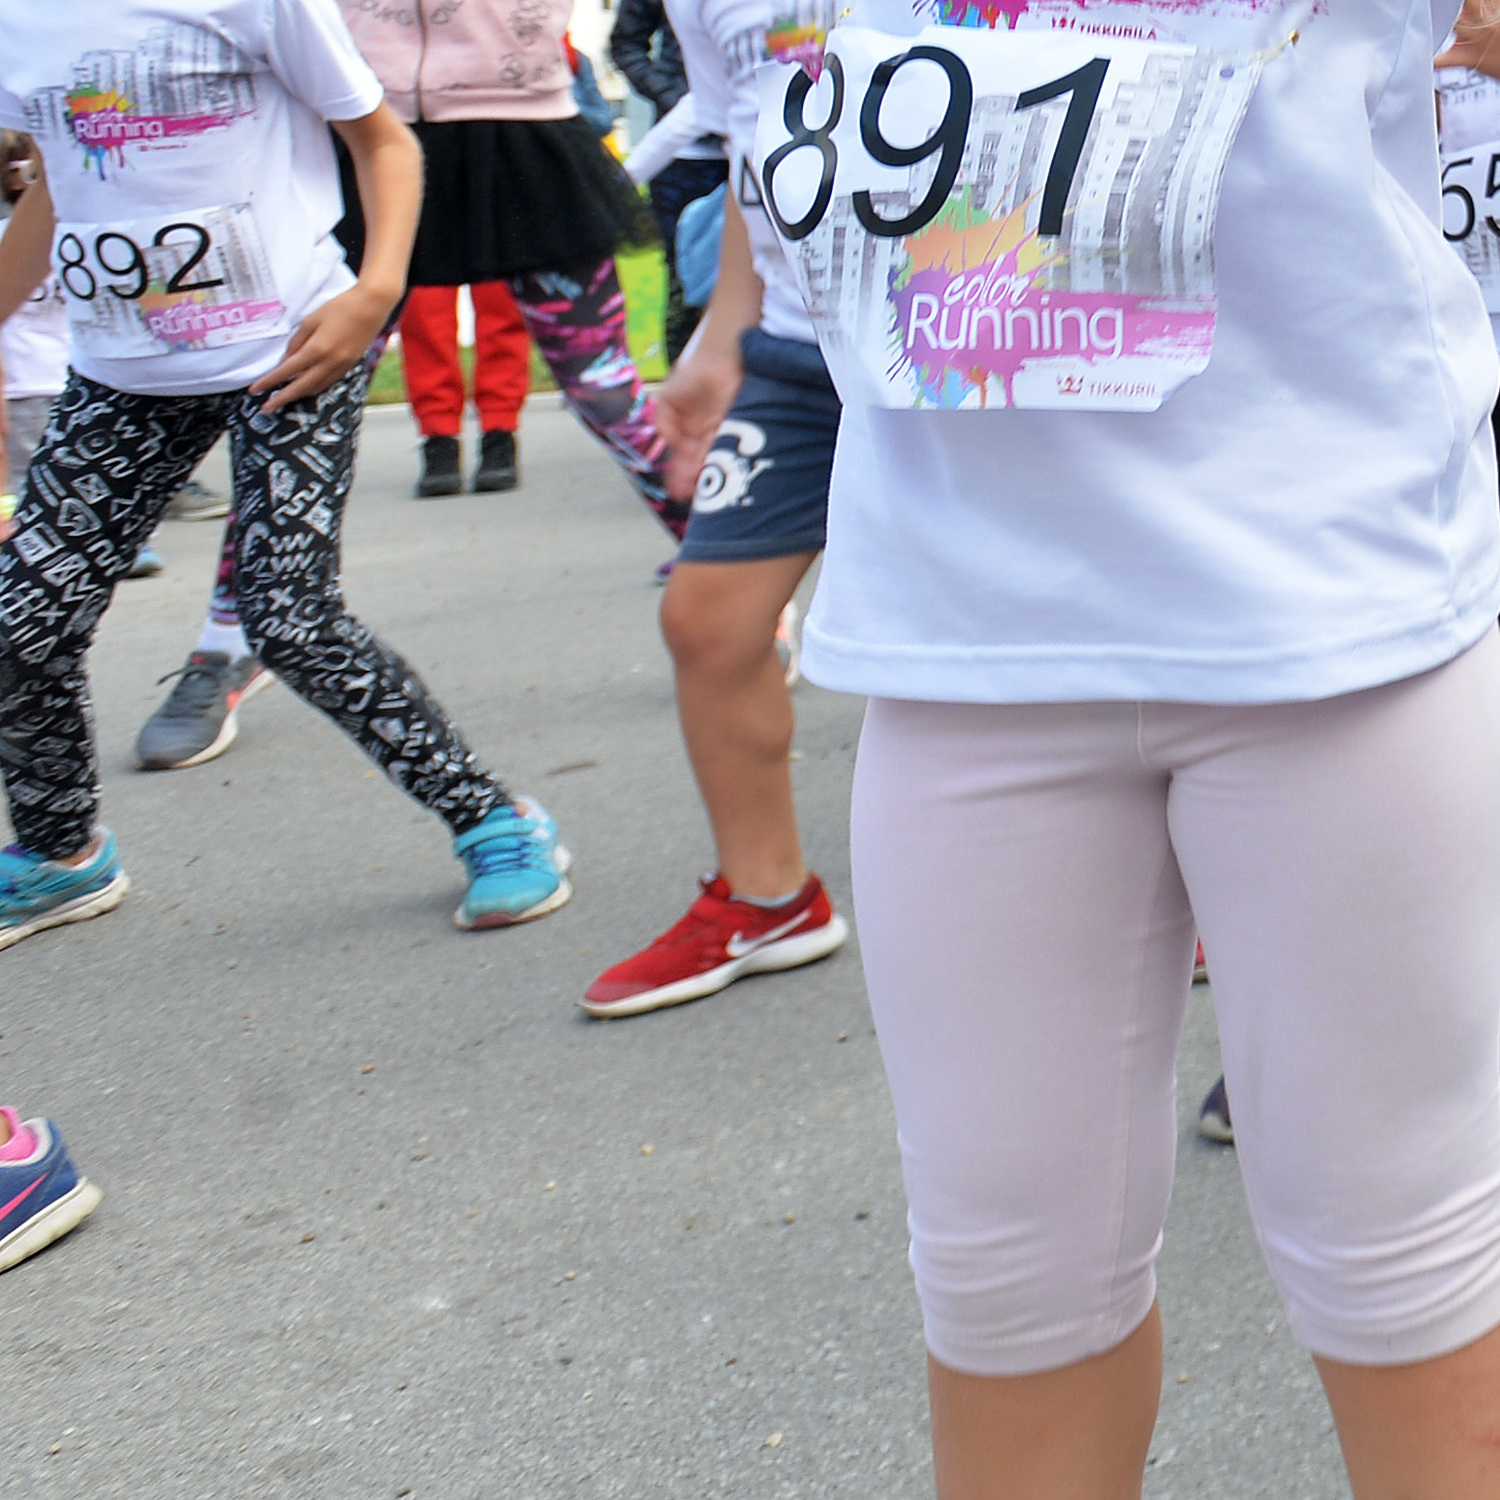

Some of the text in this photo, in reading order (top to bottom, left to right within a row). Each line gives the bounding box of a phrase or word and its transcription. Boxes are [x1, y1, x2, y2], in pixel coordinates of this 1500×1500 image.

[1080, 18, 1157, 41] TIKKURILA
[73, 115, 164, 142] Running
[762, 45, 1112, 241] 891
[58, 222, 225, 300] 892
[943, 251, 1031, 307] color
[150, 304, 247, 337] Running
[906, 292, 1124, 362] Running
[1089, 381, 1158, 398] TIKKURIL
